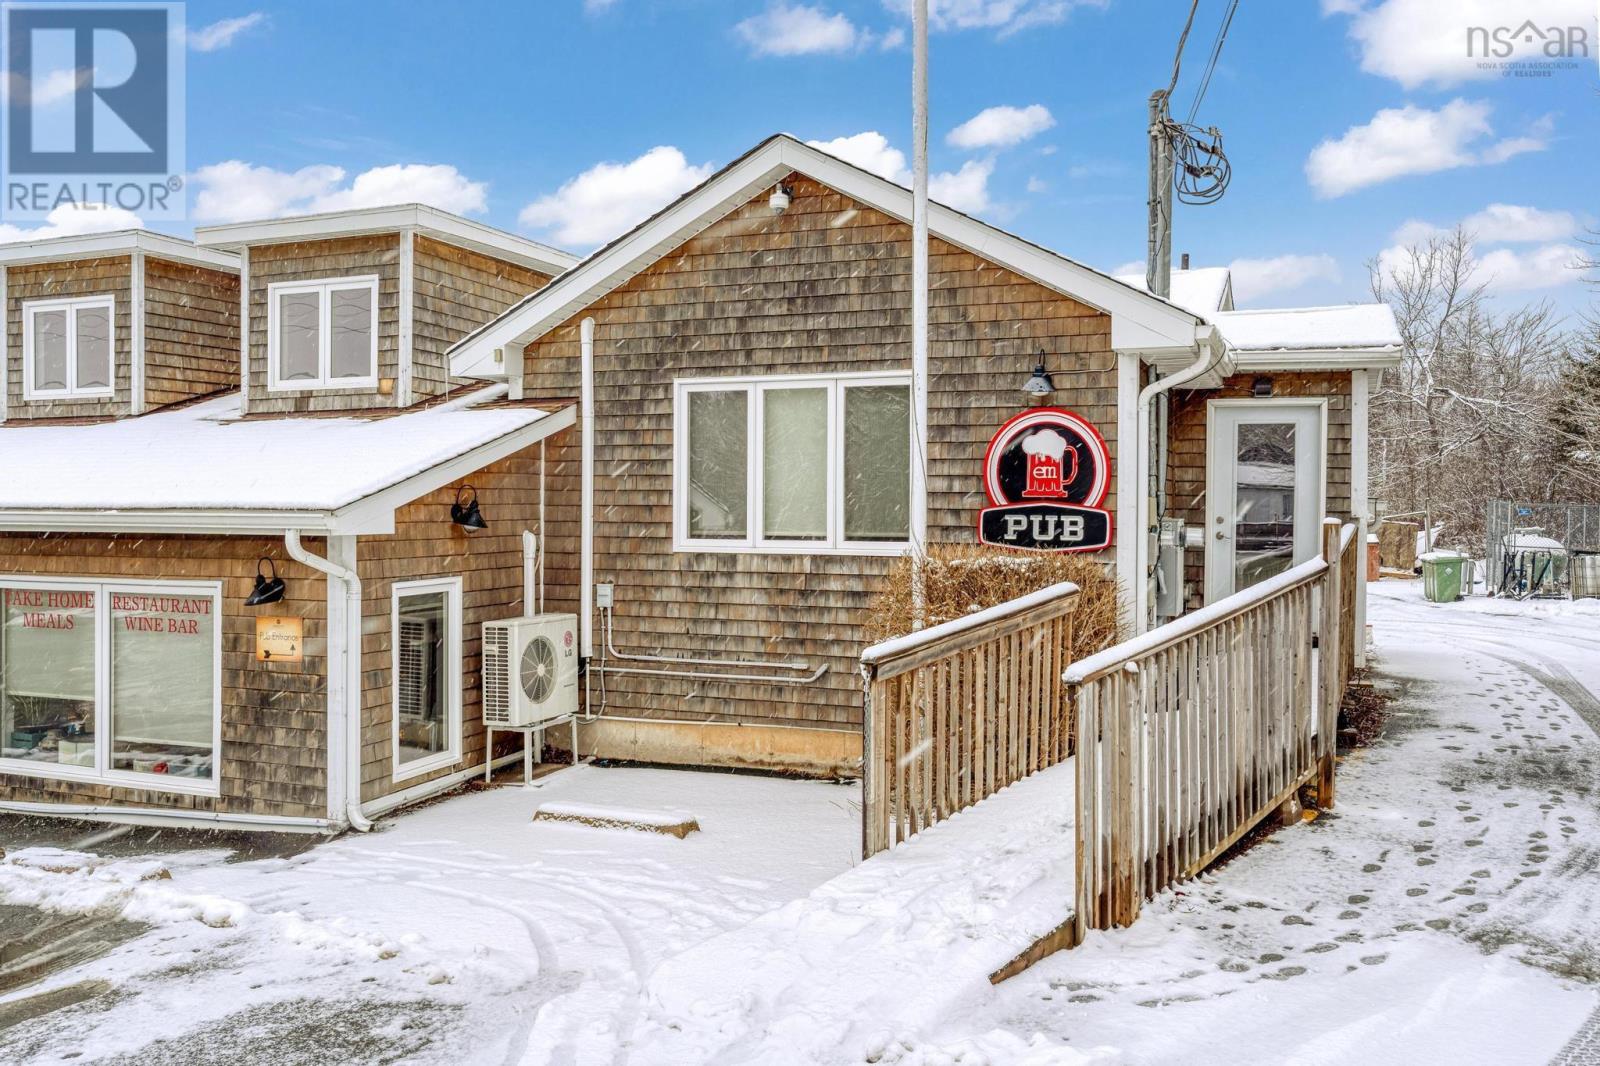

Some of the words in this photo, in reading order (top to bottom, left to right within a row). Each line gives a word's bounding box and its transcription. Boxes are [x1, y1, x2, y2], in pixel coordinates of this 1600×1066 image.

[1004, 515, 1084, 541] PUB
[5, 589, 43, 608] TAKE
[48, 592, 95, 609] HOME
[112, 594, 212, 615] RESTAURANT
[23, 612, 74, 630] MEALS
[125, 616, 164, 632] WINE
[168, 619, 199, 634] BAR
[564, 648, 573, 657] LG
